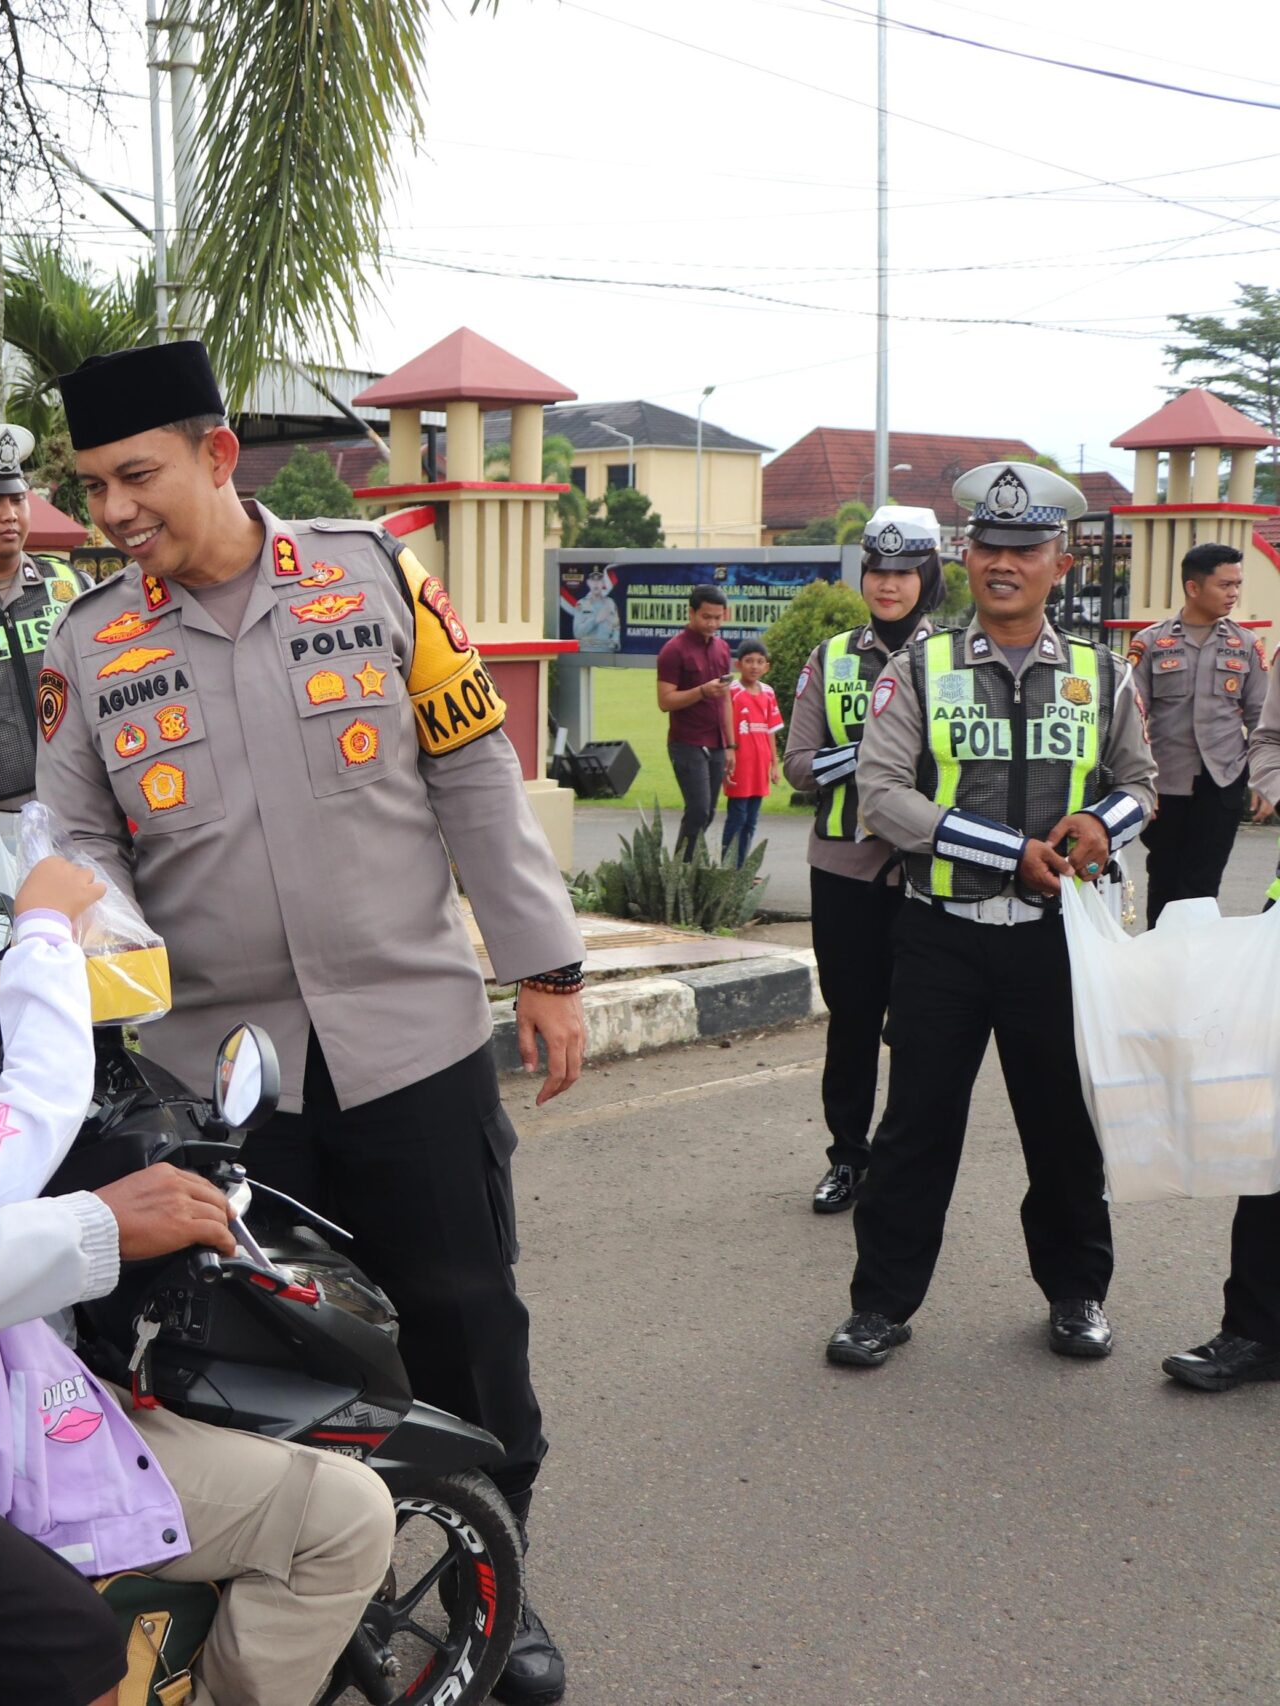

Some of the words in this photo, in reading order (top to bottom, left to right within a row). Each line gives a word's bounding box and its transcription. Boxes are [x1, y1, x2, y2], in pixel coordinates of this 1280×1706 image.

[768, 585, 804, 597] INTEGR
[631, 602, 673, 621] WILAYAH
[735, 603, 780, 623] KORUPSI
[289, 622, 384, 662] POLRI
[98, 674, 170, 719] AGUNG
[174, 669, 189, 692] A
[827, 682, 863, 694] ALMA
[417, 668, 499, 744] KAOP
[933, 705, 984, 721] AAN
[1046, 705, 1095, 725] POLRI
